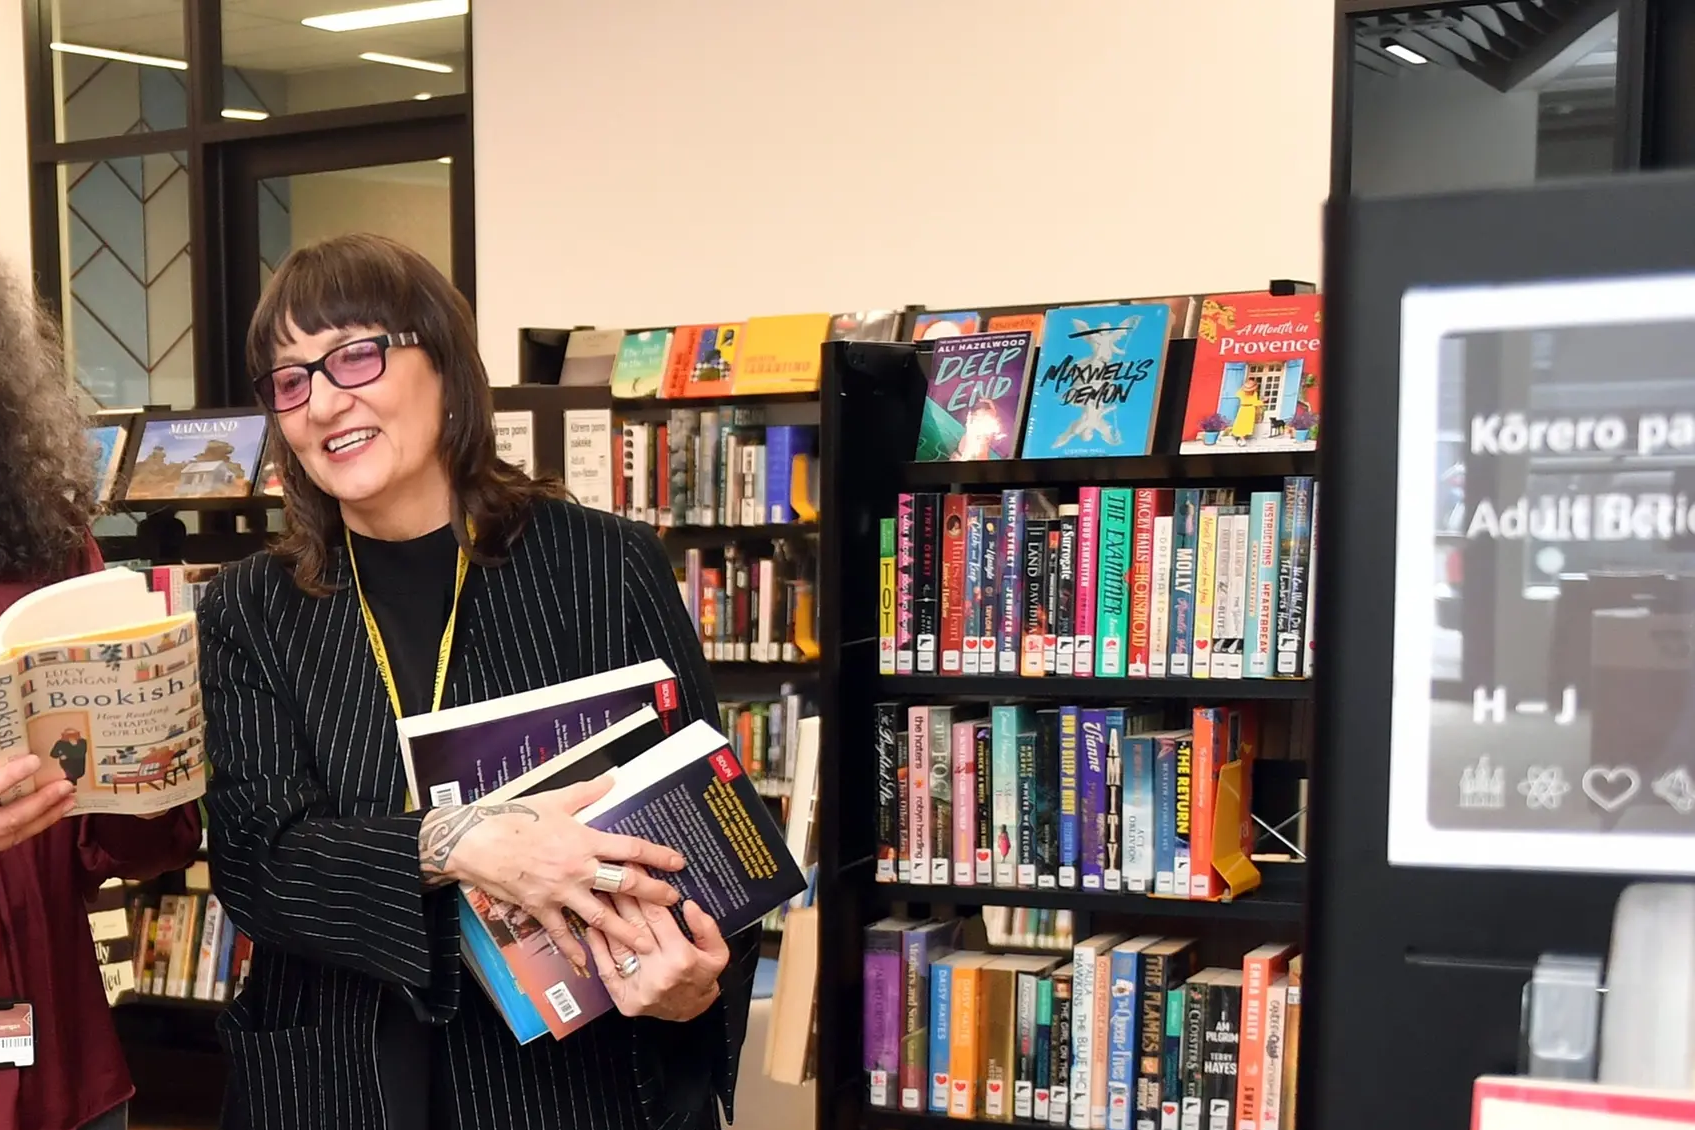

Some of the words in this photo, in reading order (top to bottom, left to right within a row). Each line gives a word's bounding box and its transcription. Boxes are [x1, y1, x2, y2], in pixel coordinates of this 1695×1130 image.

[958, 339, 1026, 352] HAZELWOOD
[1218, 336, 1320, 356] Provence
[1235, 324, 1252, 337] A
[934, 348, 1022, 386] DEEP
[1040, 355, 1154, 393] MAXWELL'S
[947, 377, 1013, 412] END
[1061, 382, 1135, 410] DEMON
[169, 421, 238, 435] MAINLAND
[1007, 496, 1017, 530] MERCY
[1106, 496, 1126, 525] THE
[1137, 490, 1152, 529] STACEY
[1284, 484, 1297, 532] HANNAH
[1007, 531, 1016, 568] STREET
[1135, 533, 1151, 562] HALLS
[1262, 502, 1276, 567] INSTRUCTIONS
[952, 541, 966, 578] Rules
[985, 549, 996, 581] Lifestyle
[1027, 541, 1039, 578] LAND
[1060, 530, 1074, 580] Surrogate
[1081, 541, 1091, 588] SAMARITAN
[968, 562, 981, 583] Keep
[1102, 528, 1126, 616] EXAMINER
[1174, 548, 1194, 595] MOLLY
[950, 606, 964, 642] Heart
[1005, 586, 1015, 633] JENNIFER
[1131, 574, 1149, 648] HOUSEHOLD
[1259, 584, 1272, 654] HEARTBREAK
[44, 668, 85, 679] LUCY
[46, 676, 119, 688] MANGAN
[49, 678, 186, 709] Bookish
[1472, 687, 1506, 724] H
[1554, 686, 1578, 725] J
[110, 718, 157, 729] SHAPES
[134, 724, 168, 737] LIVES
[915, 716, 925, 733] the
[934, 721, 946, 748] THE
[1061, 714, 1076, 735] HOW
[915, 734, 925, 770] haters
[1061, 737, 1076, 749] TO
[1082, 722, 1104, 773] Vianne
[931, 750, 949, 793] FOG
[1062, 749, 1076, 775] SLEEP
[1176, 747, 1190, 775] THE
[1062, 776, 1076, 788] AT
[914, 796, 925, 823] robyn
[1106, 728, 1121, 869] AMITY
[1176, 776, 1190, 834] RETURN
[914, 824, 926, 859] harding
[1022, 830, 1030, 865] BELONG
[1128, 815, 1137, 864] OBLIVION
[1136, 829, 1145, 849] ACT
[907, 943, 920, 985] Mothers
[1073, 952, 1084, 1007] HAWKINS
[1085, 962, 1094, 996] PAULA
[1144, 956, 1163, 987] THE
[1248, 963, 1261, 995] EMMA
[937, 969, 948, 1000] DAISY
[907, 1008, 918, 1033] Sons
[937, 1003, 947, 1040] HAITES
[1060, 1001, 1069, 1020] THE
[1077, 1013, 1087, 1033] THE
[1110, 1008, 1133, 1043] Queen
[1141, 991, 1162, 1053] FLAMES
[1215, 1021, 1230, 1032] AM
[1245, 999, 1261, 1042] HEALEY
[1059, 1021, 1068, 1042] GIRL
[1185, 1009, 1202, 1070] CLOISTERS
[1205, 1031, 1239, 1043] PILGRIM
[1059, 1045, 1068, 1060] ON
[1077, 1036, 1088, 1066] BLUE
[1210, 1052, 1233, 1062] TERRY
[1058, 1061, 1067, 1081] THE
[1204, 1060, 1237, 1076] HAYES
